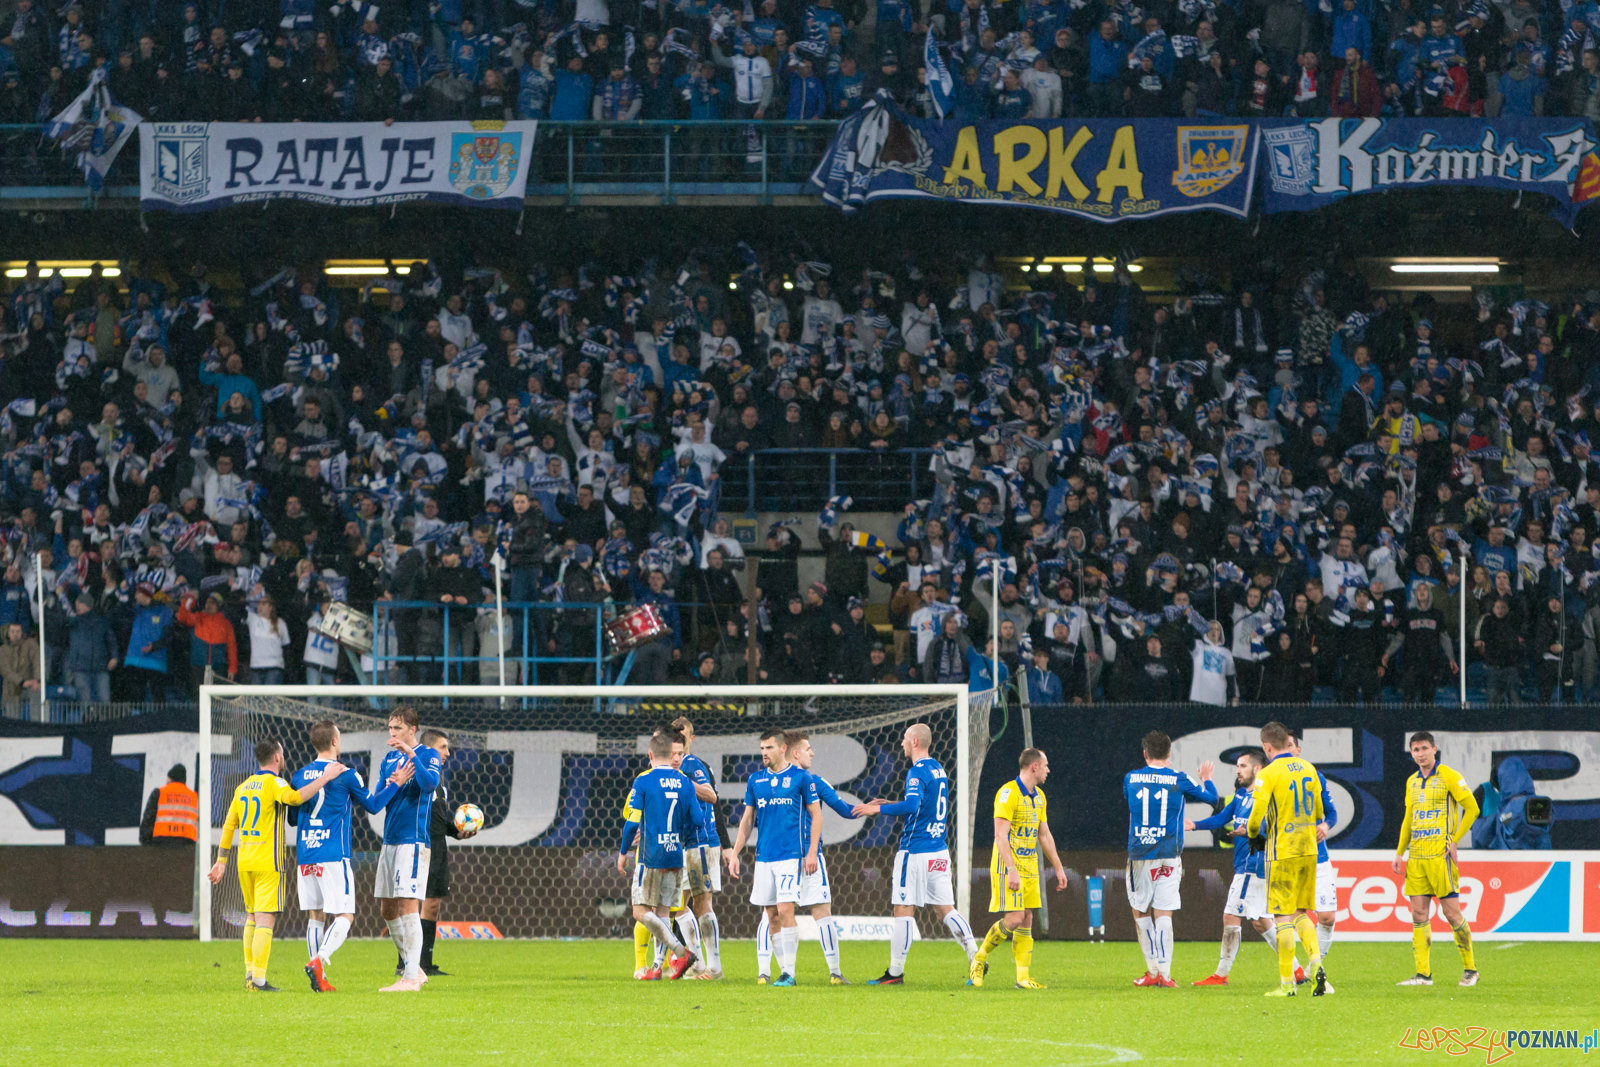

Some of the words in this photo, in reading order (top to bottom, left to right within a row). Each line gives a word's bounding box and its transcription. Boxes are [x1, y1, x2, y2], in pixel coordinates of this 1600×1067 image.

[180, 125, 204, 134] LECH
[1270, 133, 1286, 141] KKS
[224, 136, 436, 192] RATAJE
[943, 125, 1144, 203] ARKA
[1183, 169, 1234, 182] ARKA
[1286, 762, 1304, 772] DEJA
[303, 769, 325, 780] GUM
[660, 778, 682, 790] GAJOS
[769, 797, 793, 806] AFORTI
[936, 781, 947, 821] 6
[1289, 776, 1315, 817] 16
[664, 791, 679, 832] 7
[1135, 786, 1169, 826] 11
[240, 795, 261, 837] 22
[1414, 809, 1442, 820] BET
[301, 829, 331, 841] LECH
[1016, 826, 1038, 838] LVB
[1134, 826, 1167, 838] LECH
[780, 874, 795, 891] 77
[1011, 891, 1023, 908] 11
